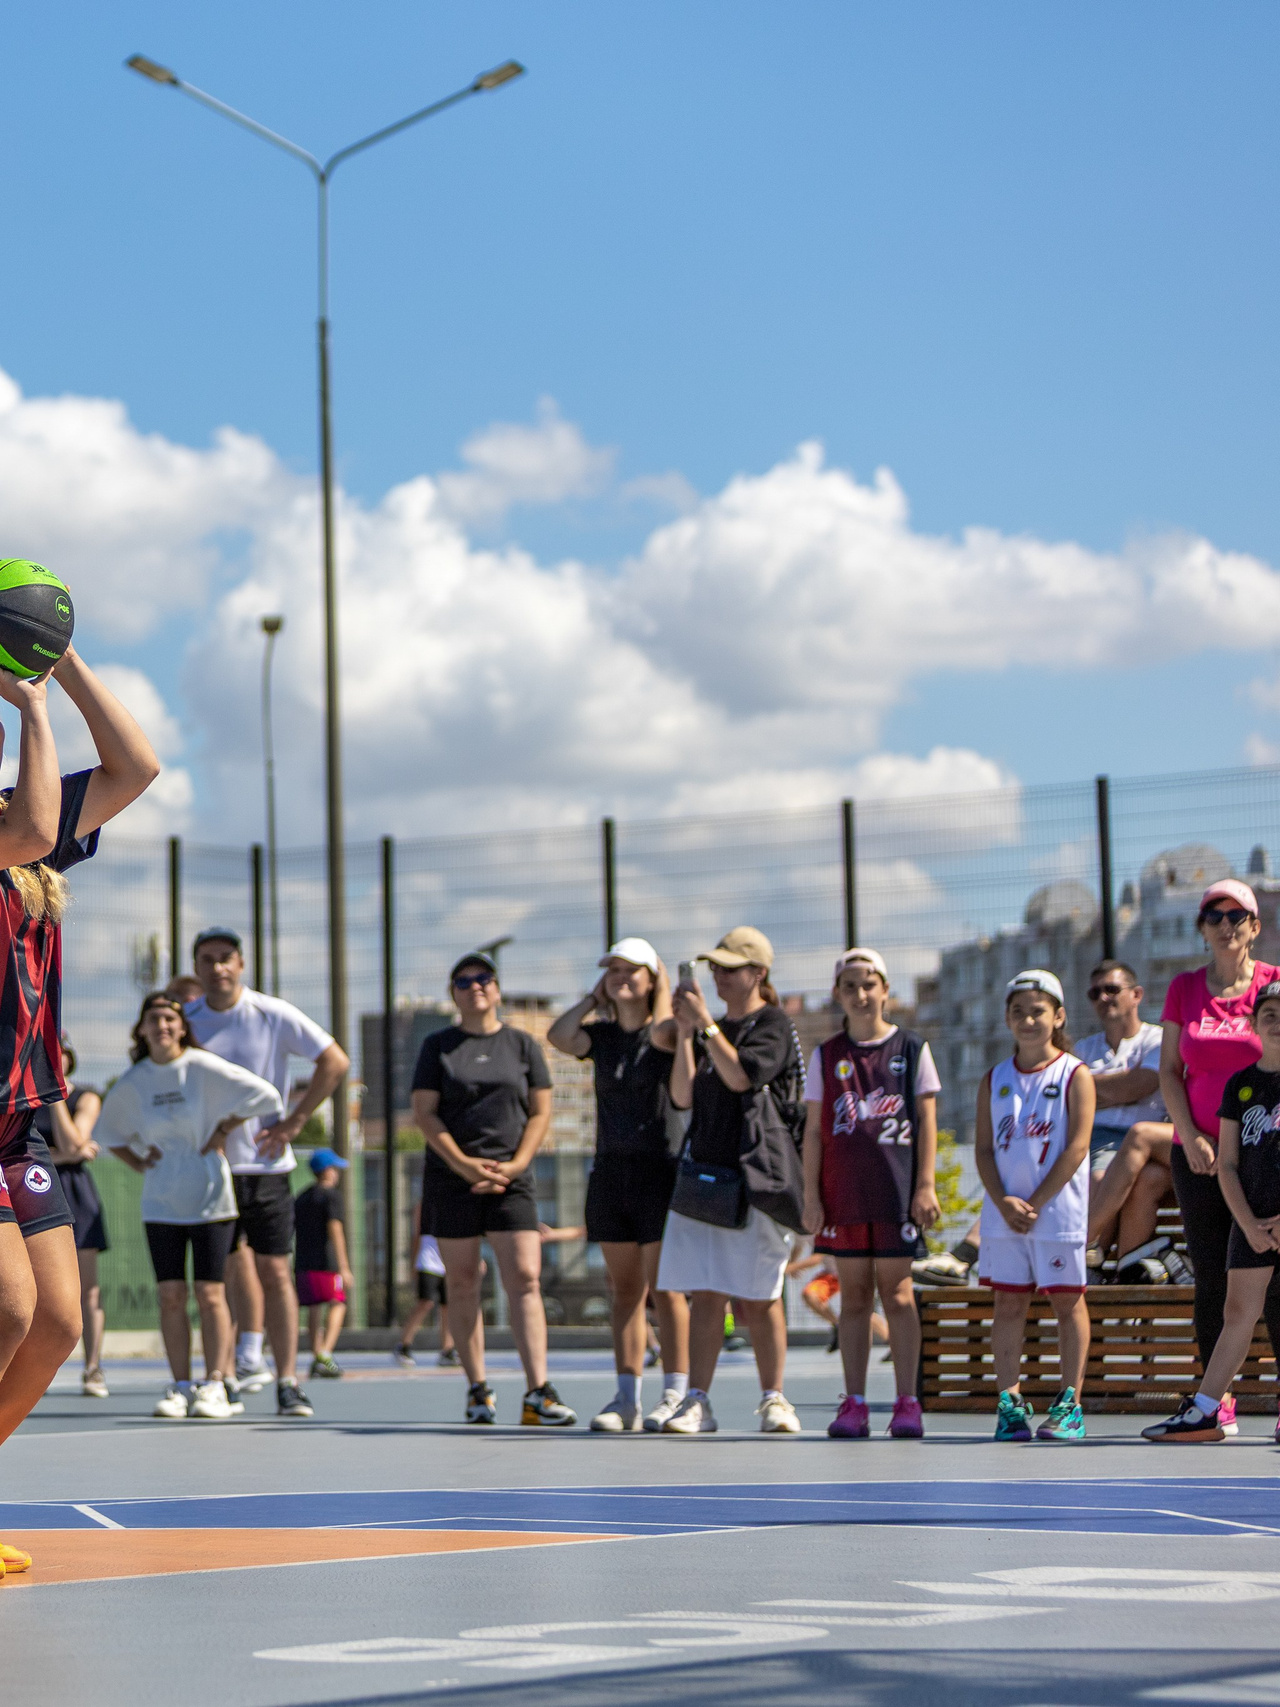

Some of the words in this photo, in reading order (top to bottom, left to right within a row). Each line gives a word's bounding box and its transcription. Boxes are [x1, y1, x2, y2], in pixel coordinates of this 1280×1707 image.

[1200, 1016, 1249, 1033] EA7
[877, 1118, 912, 1146] 22
[1039, 1141, 1051, 1165] 1
